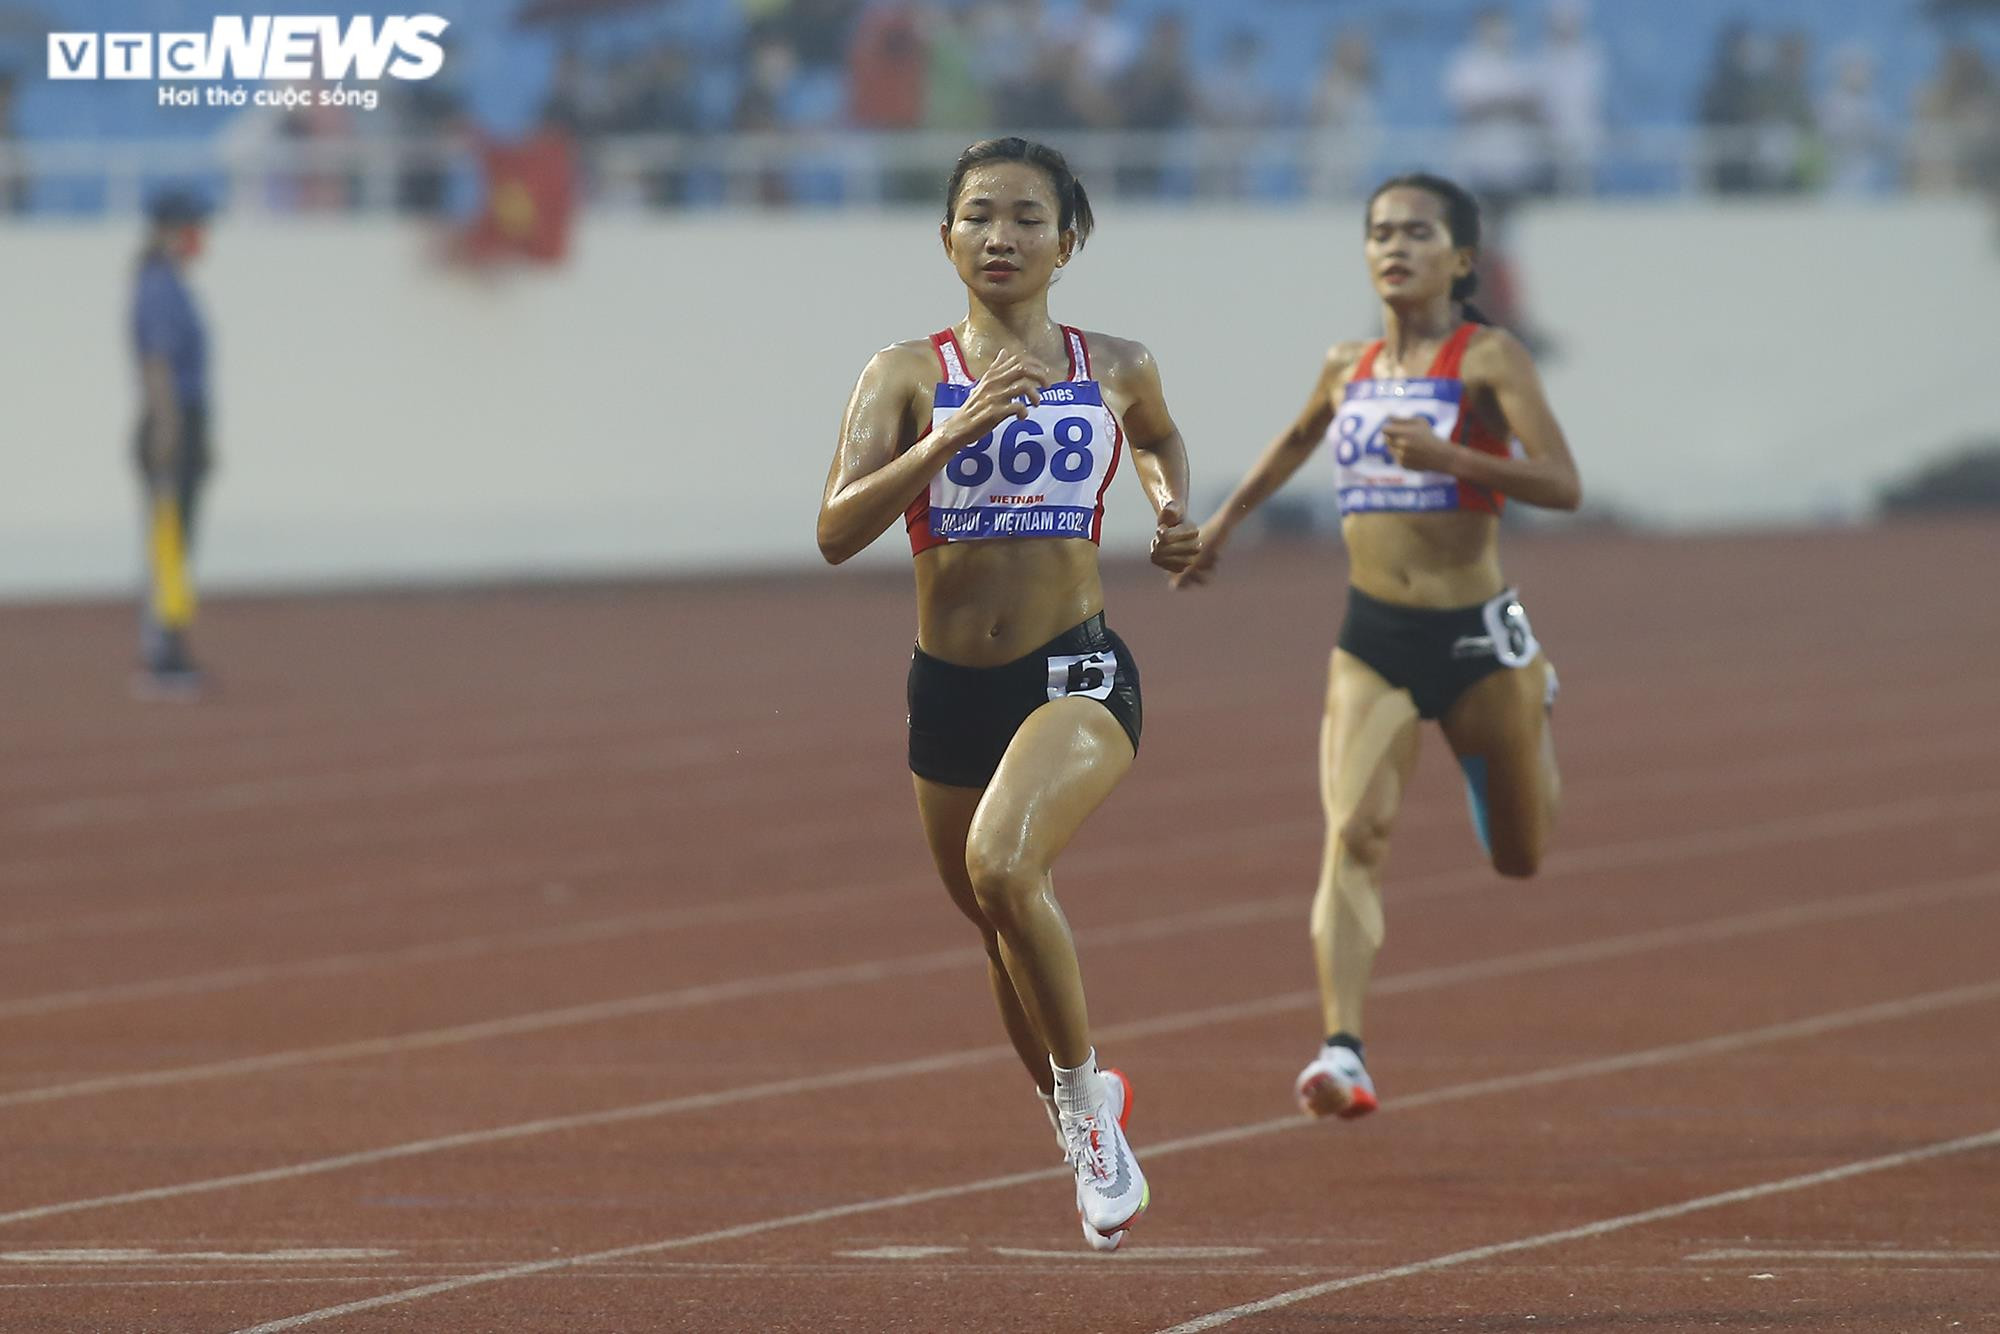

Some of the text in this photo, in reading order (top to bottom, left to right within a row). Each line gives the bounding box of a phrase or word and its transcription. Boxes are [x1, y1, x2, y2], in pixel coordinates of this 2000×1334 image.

[945, 417, 1094, 487] 868
[1337, 413, 1438, 466] 84
[990, 494, 1044, 505] VIETNAM
[994, 512, 1053, 531] VIETNAM
